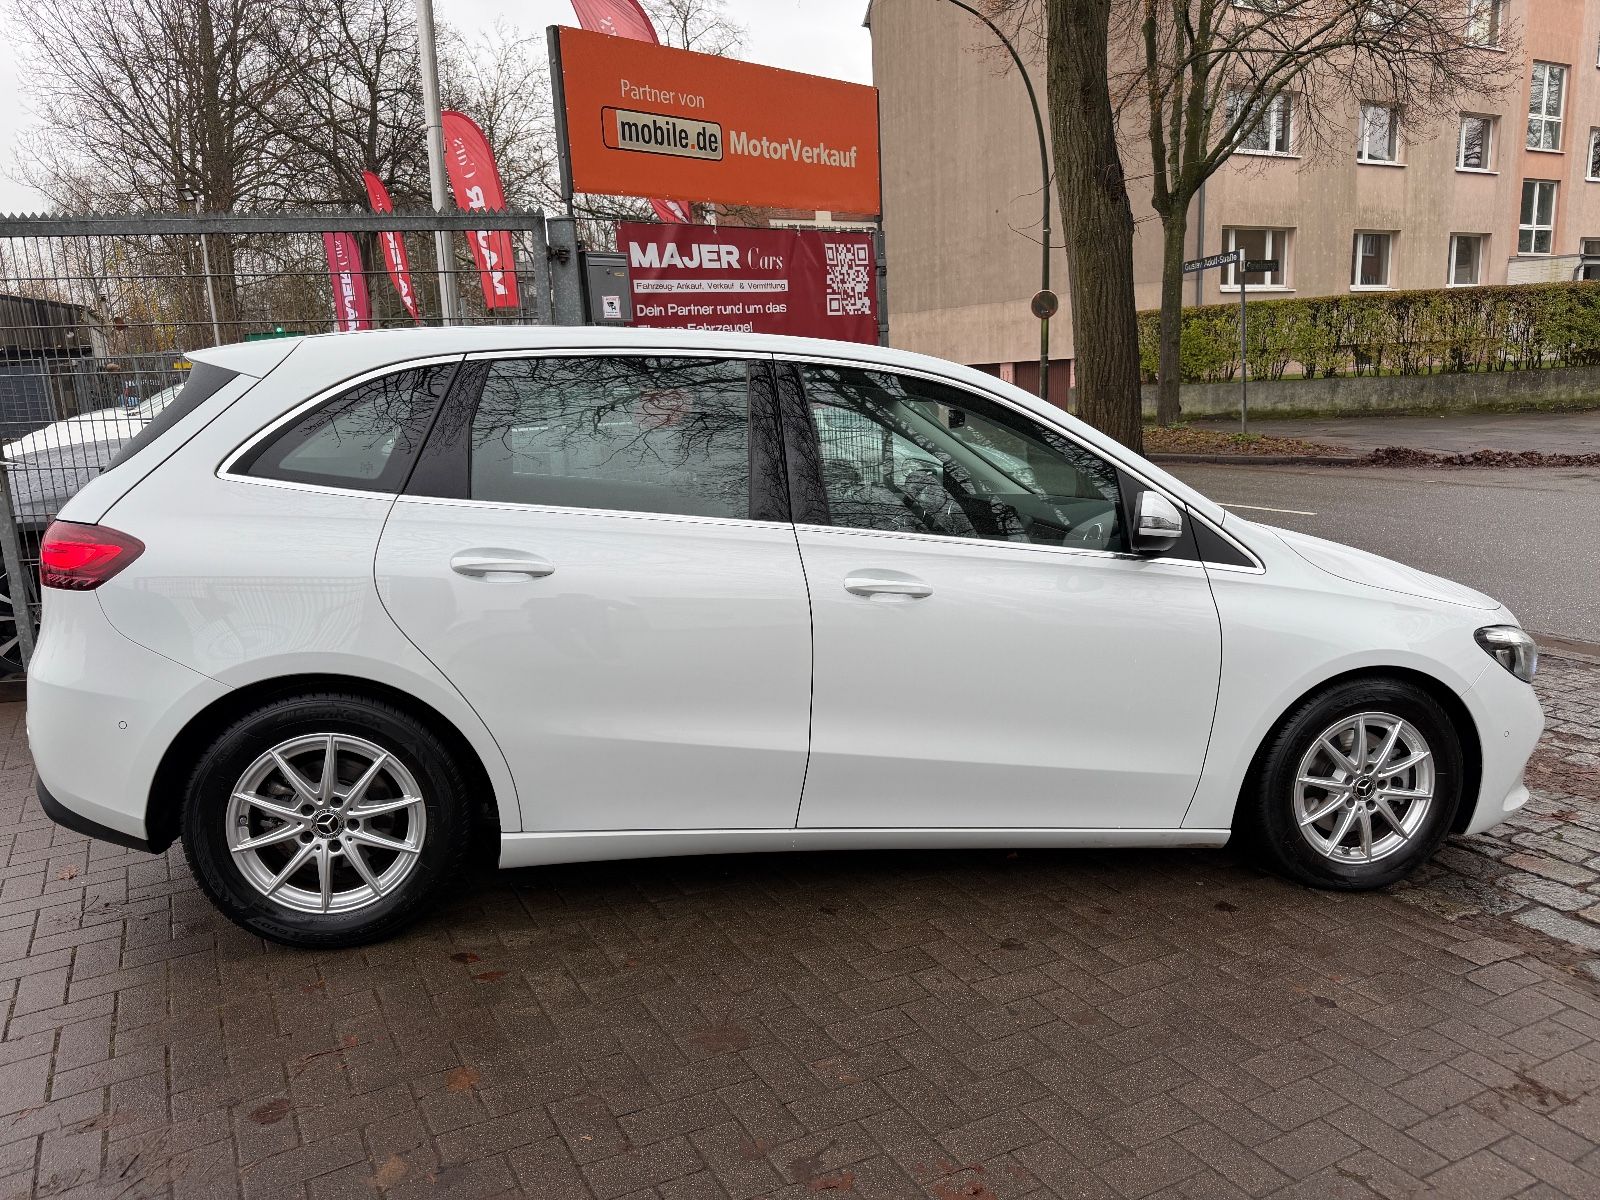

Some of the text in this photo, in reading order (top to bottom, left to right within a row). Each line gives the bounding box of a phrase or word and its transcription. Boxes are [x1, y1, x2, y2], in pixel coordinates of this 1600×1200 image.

[620, 79, 705, 108] Partner von
[620, 118, 718, 153] mobile.de
[729, 130, 857, 168] MotorVerkauf
[628, 241, 783, 270] MAJER Cars
[707, 282, 735, 290] Verkauf
[747, 282, 786, 291] Vermittlung
[636, 301, 787, 317] Dein Partner rund um das
